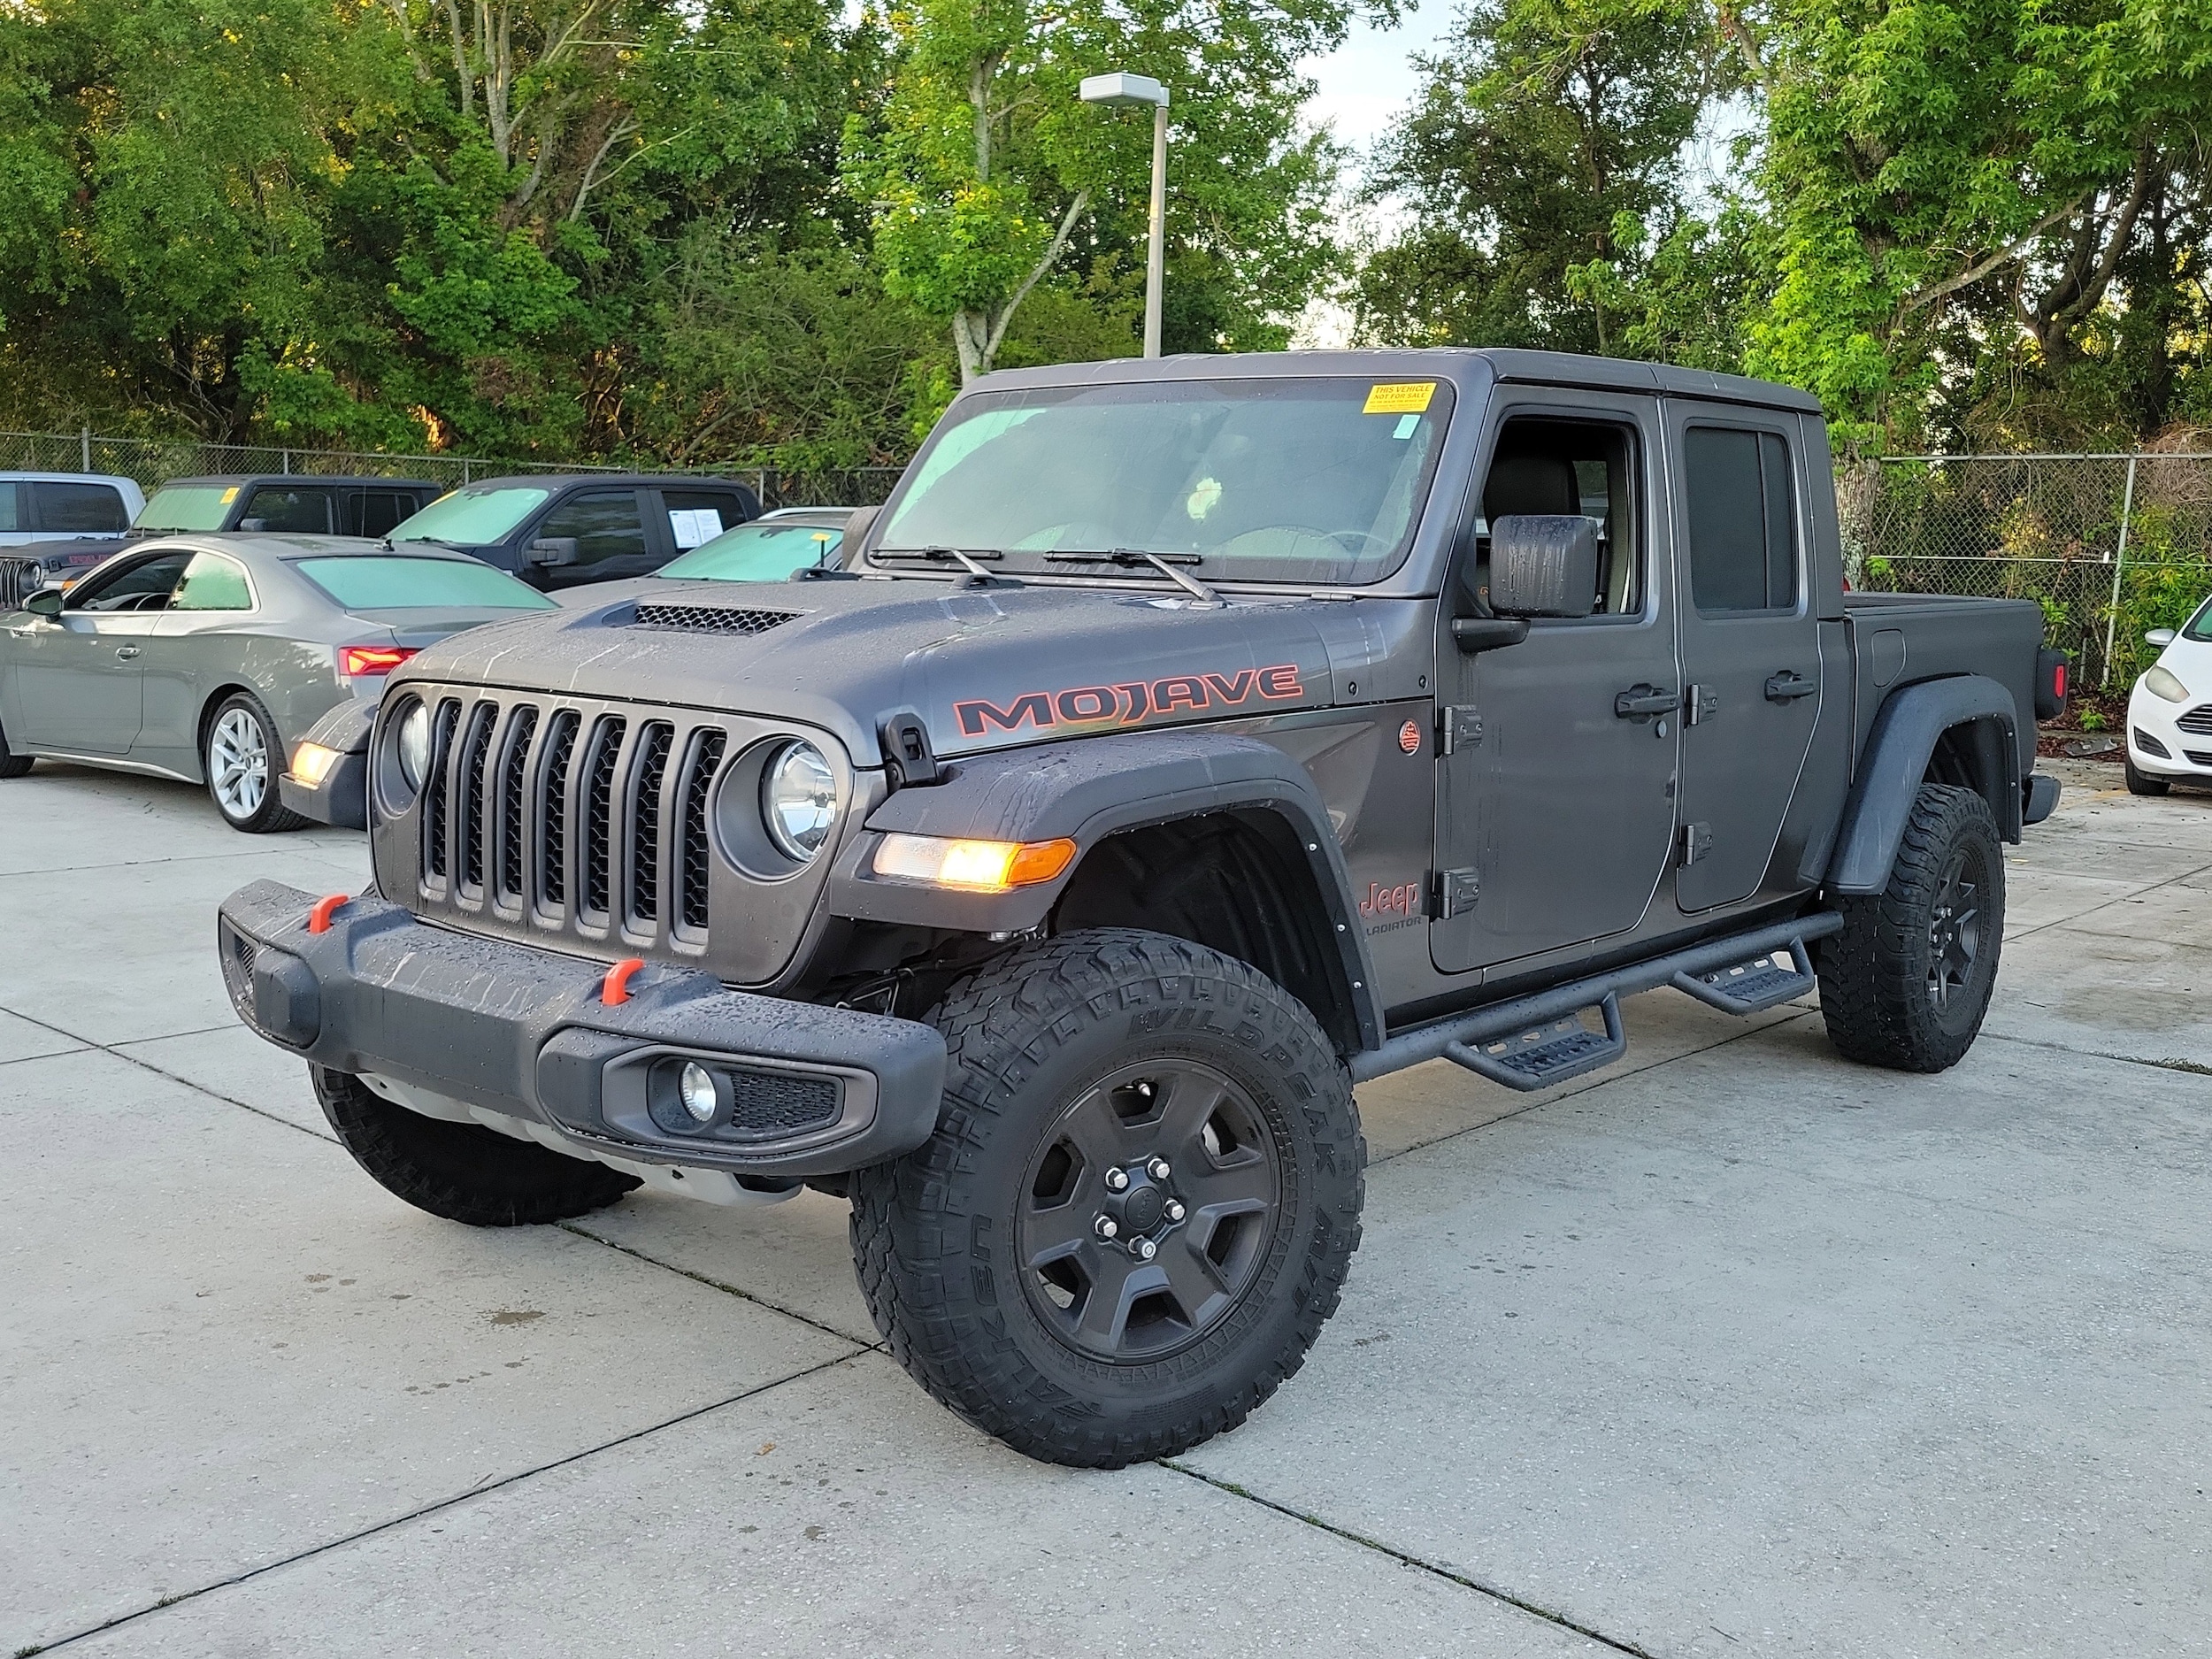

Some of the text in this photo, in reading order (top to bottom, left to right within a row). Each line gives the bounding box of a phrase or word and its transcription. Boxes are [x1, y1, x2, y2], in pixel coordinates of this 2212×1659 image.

[953, 664, 1302, 737] MOJAVE
[1360, 882, 1418, 918] Jeep
[1366, 918, 1422, 936] LADIATOR
[1129, 1006, 1337, 1176] WILDPEAK
